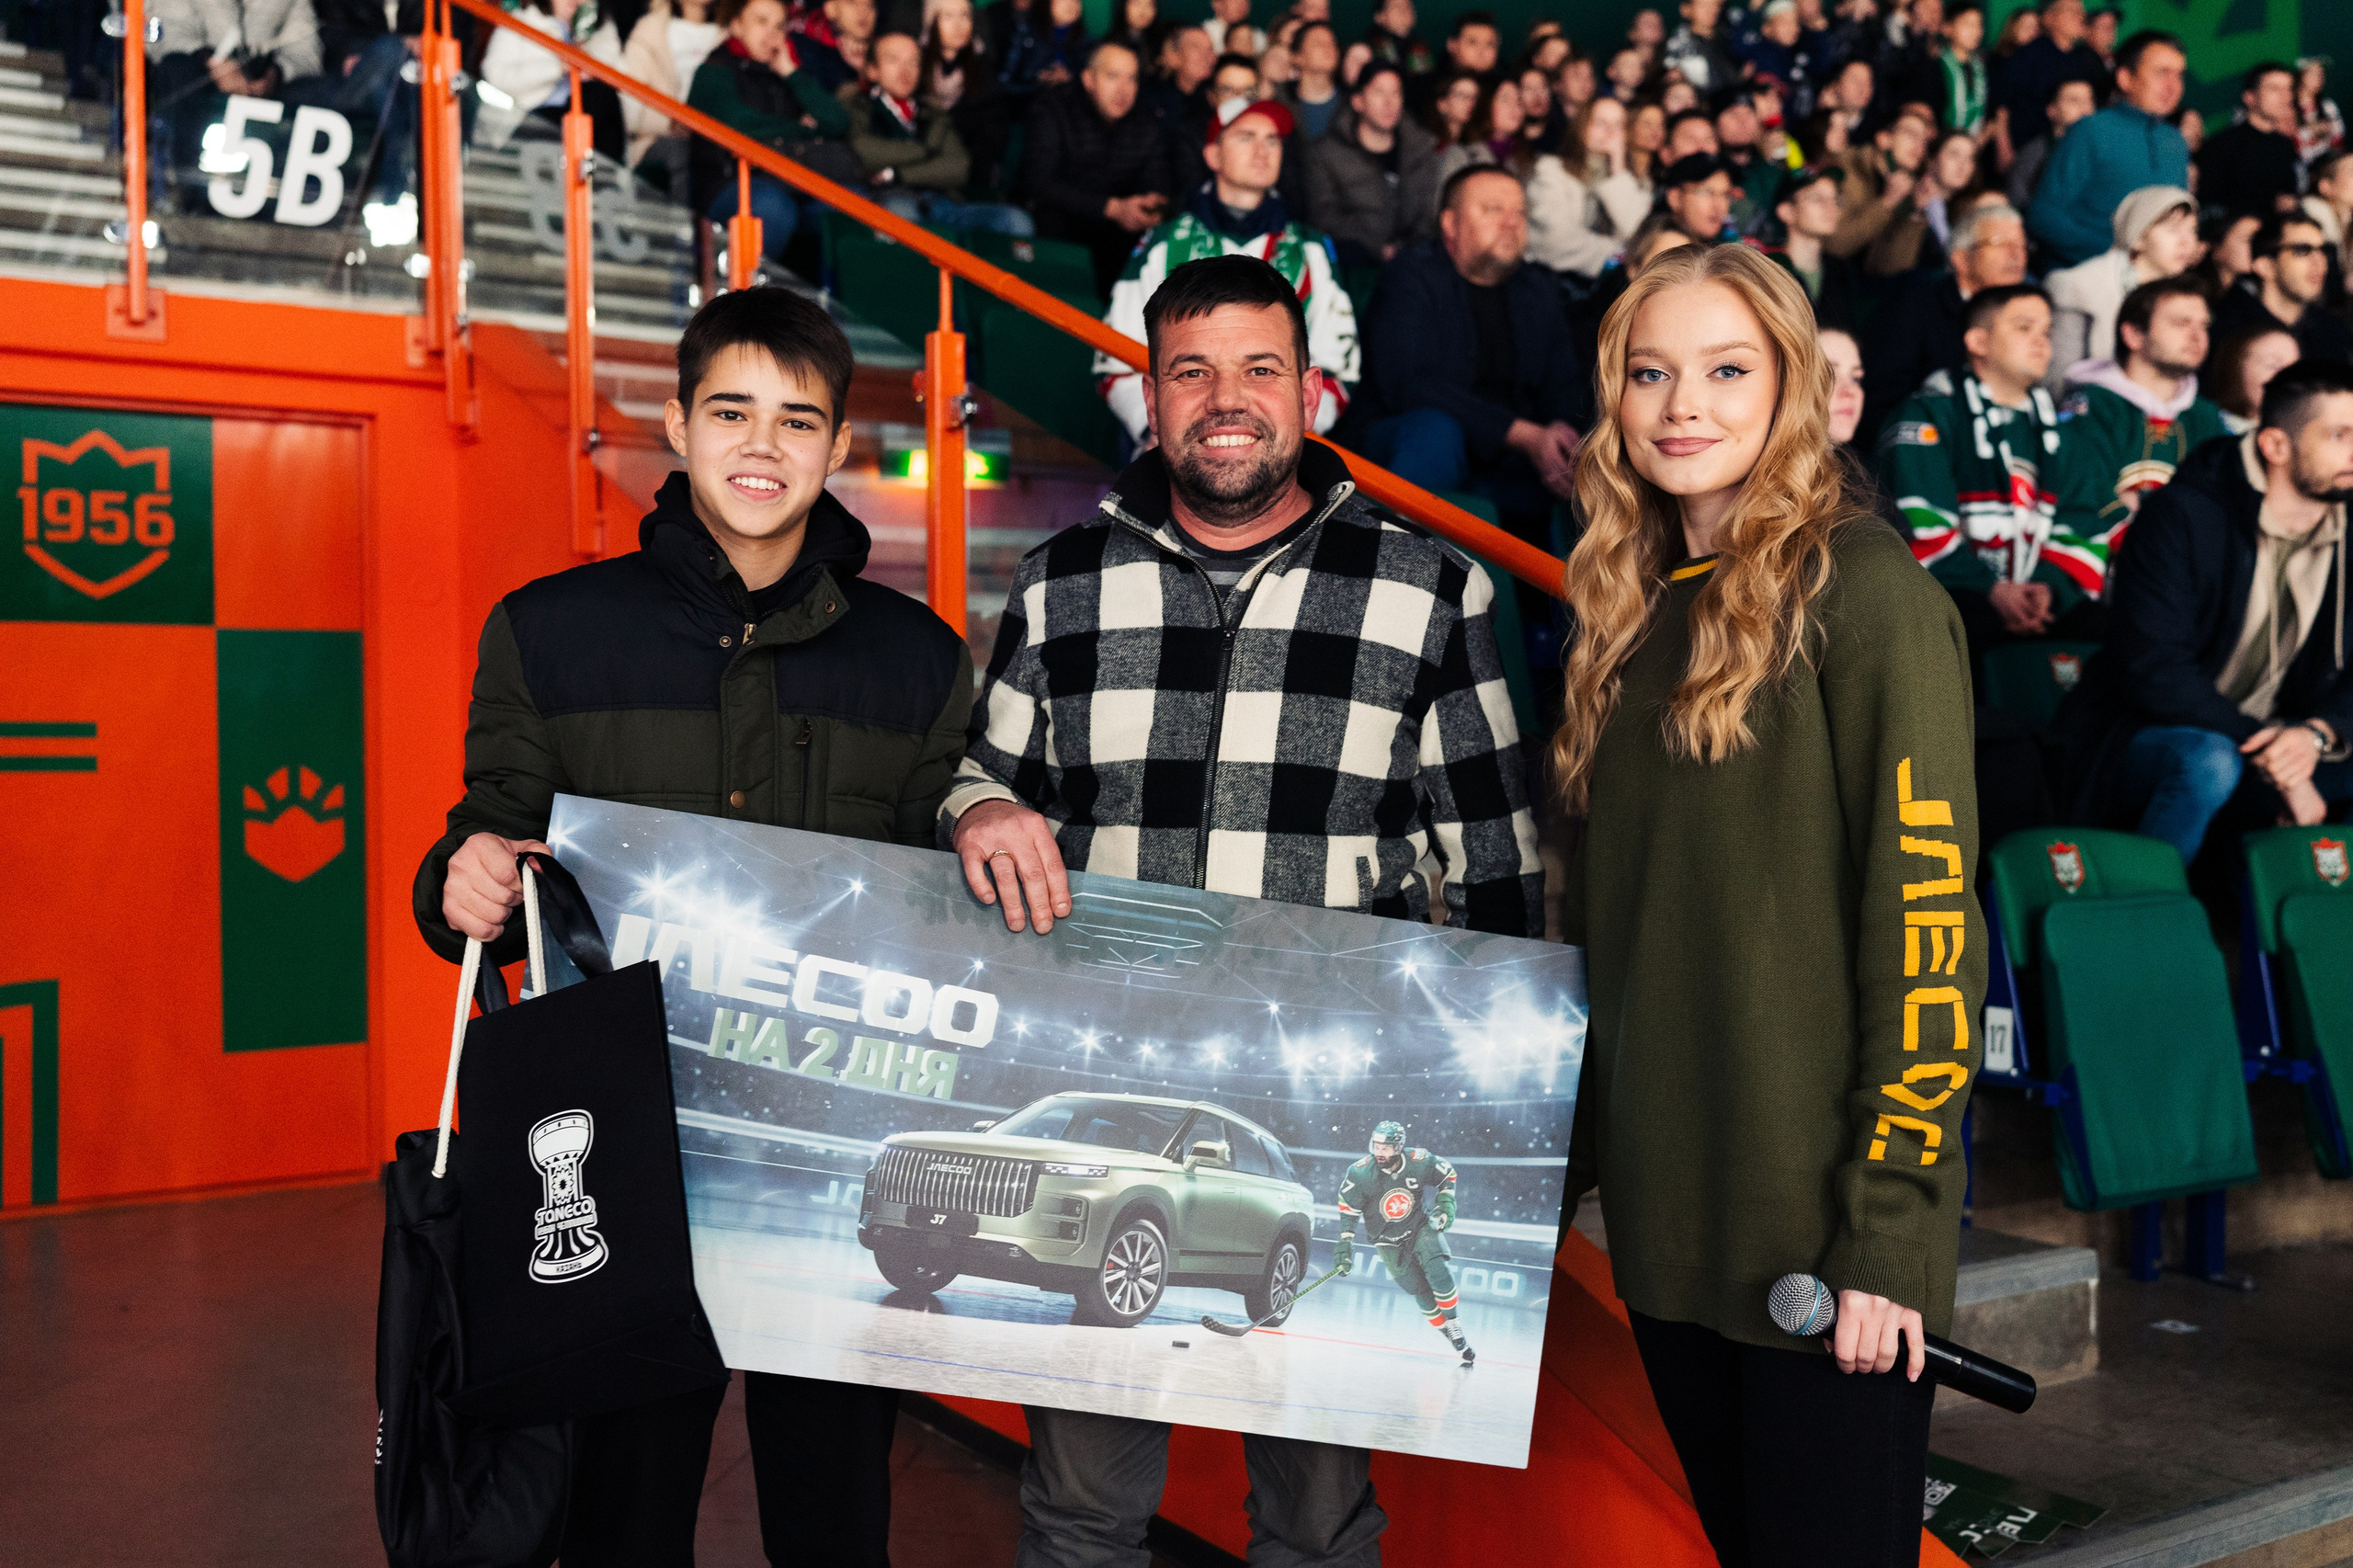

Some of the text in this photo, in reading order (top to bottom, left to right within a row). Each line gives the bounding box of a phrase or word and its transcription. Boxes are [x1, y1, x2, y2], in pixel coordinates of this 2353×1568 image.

[208, 95, 354, 227] 5B
[17, 486, 175, 547] 1956
[707, 1007, 959, 1100] НА 2 ДНЯ
[1990, 1024, 2006, 1053] 17
[926, 1162, 972, 1176] JAECOO
[929, 1213, 948, 1225] J7
